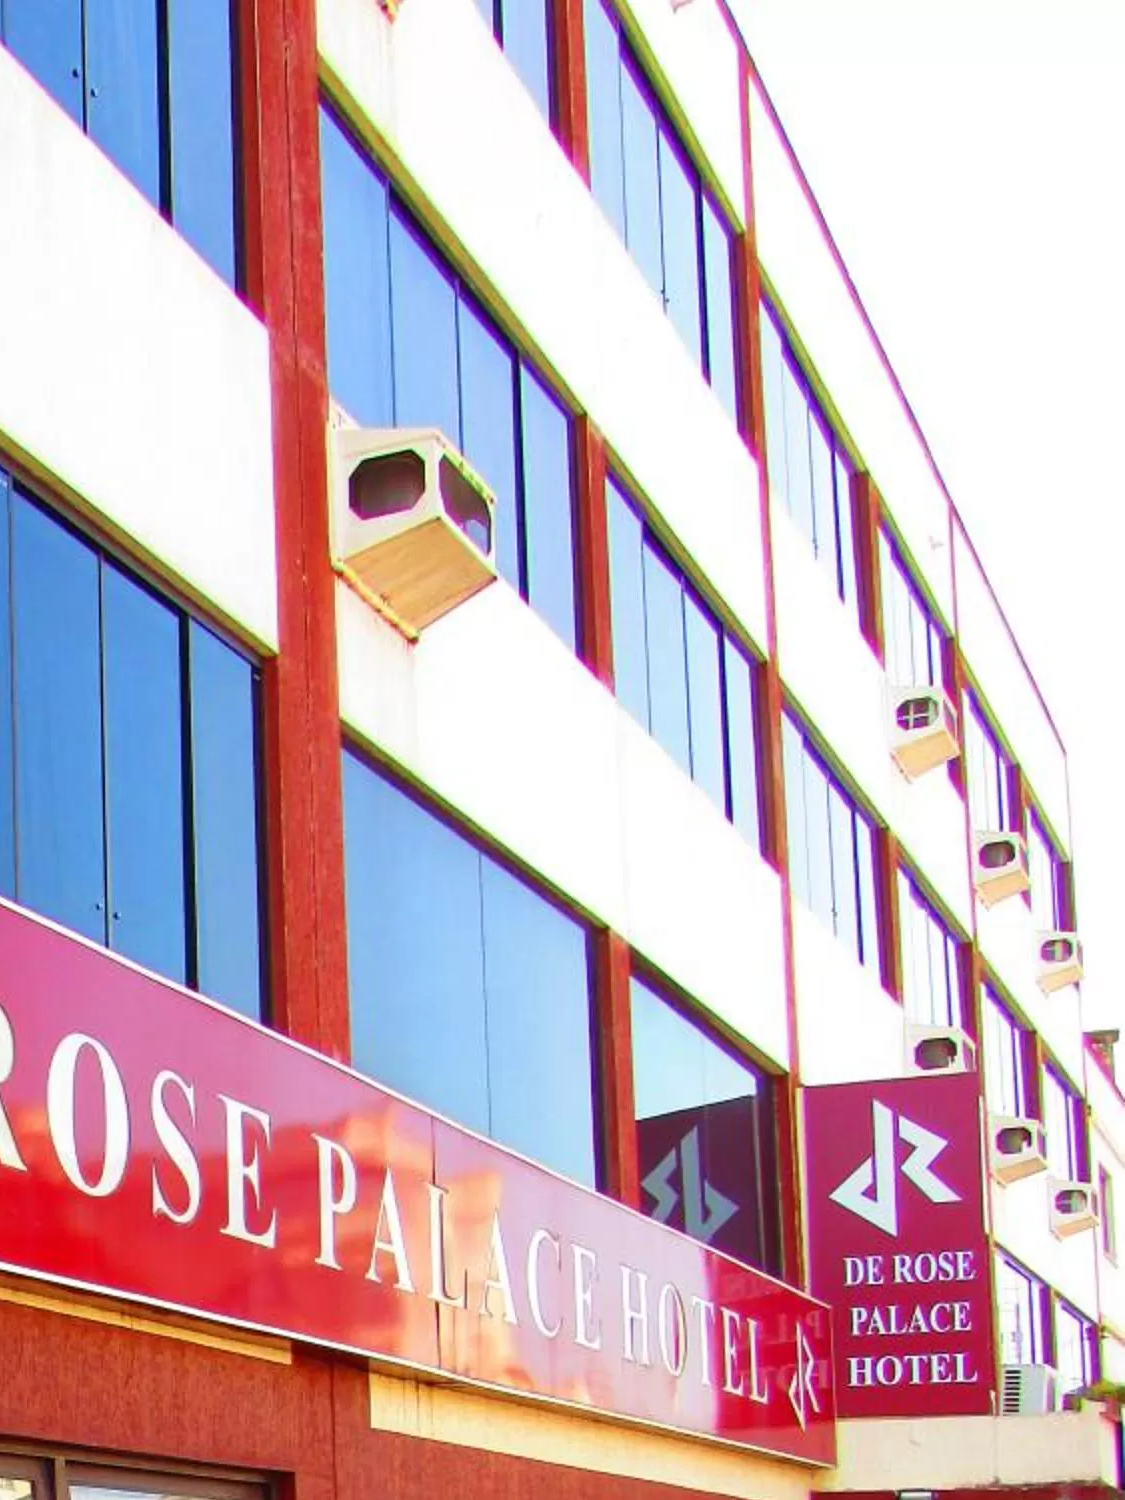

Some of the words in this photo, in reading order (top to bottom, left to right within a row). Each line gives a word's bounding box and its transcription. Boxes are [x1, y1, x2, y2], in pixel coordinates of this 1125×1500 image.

[312, 1133, 601, 1351] PALACE
[619, 1265, 768, 1404] HOTEL
[843, 1256, 884, 1286] DE
[893, 1251, 976, 1283] ROSE
[850, 1302, 972, 1336] PALACE
[847, 1353, 978, 1387] HOTEL
